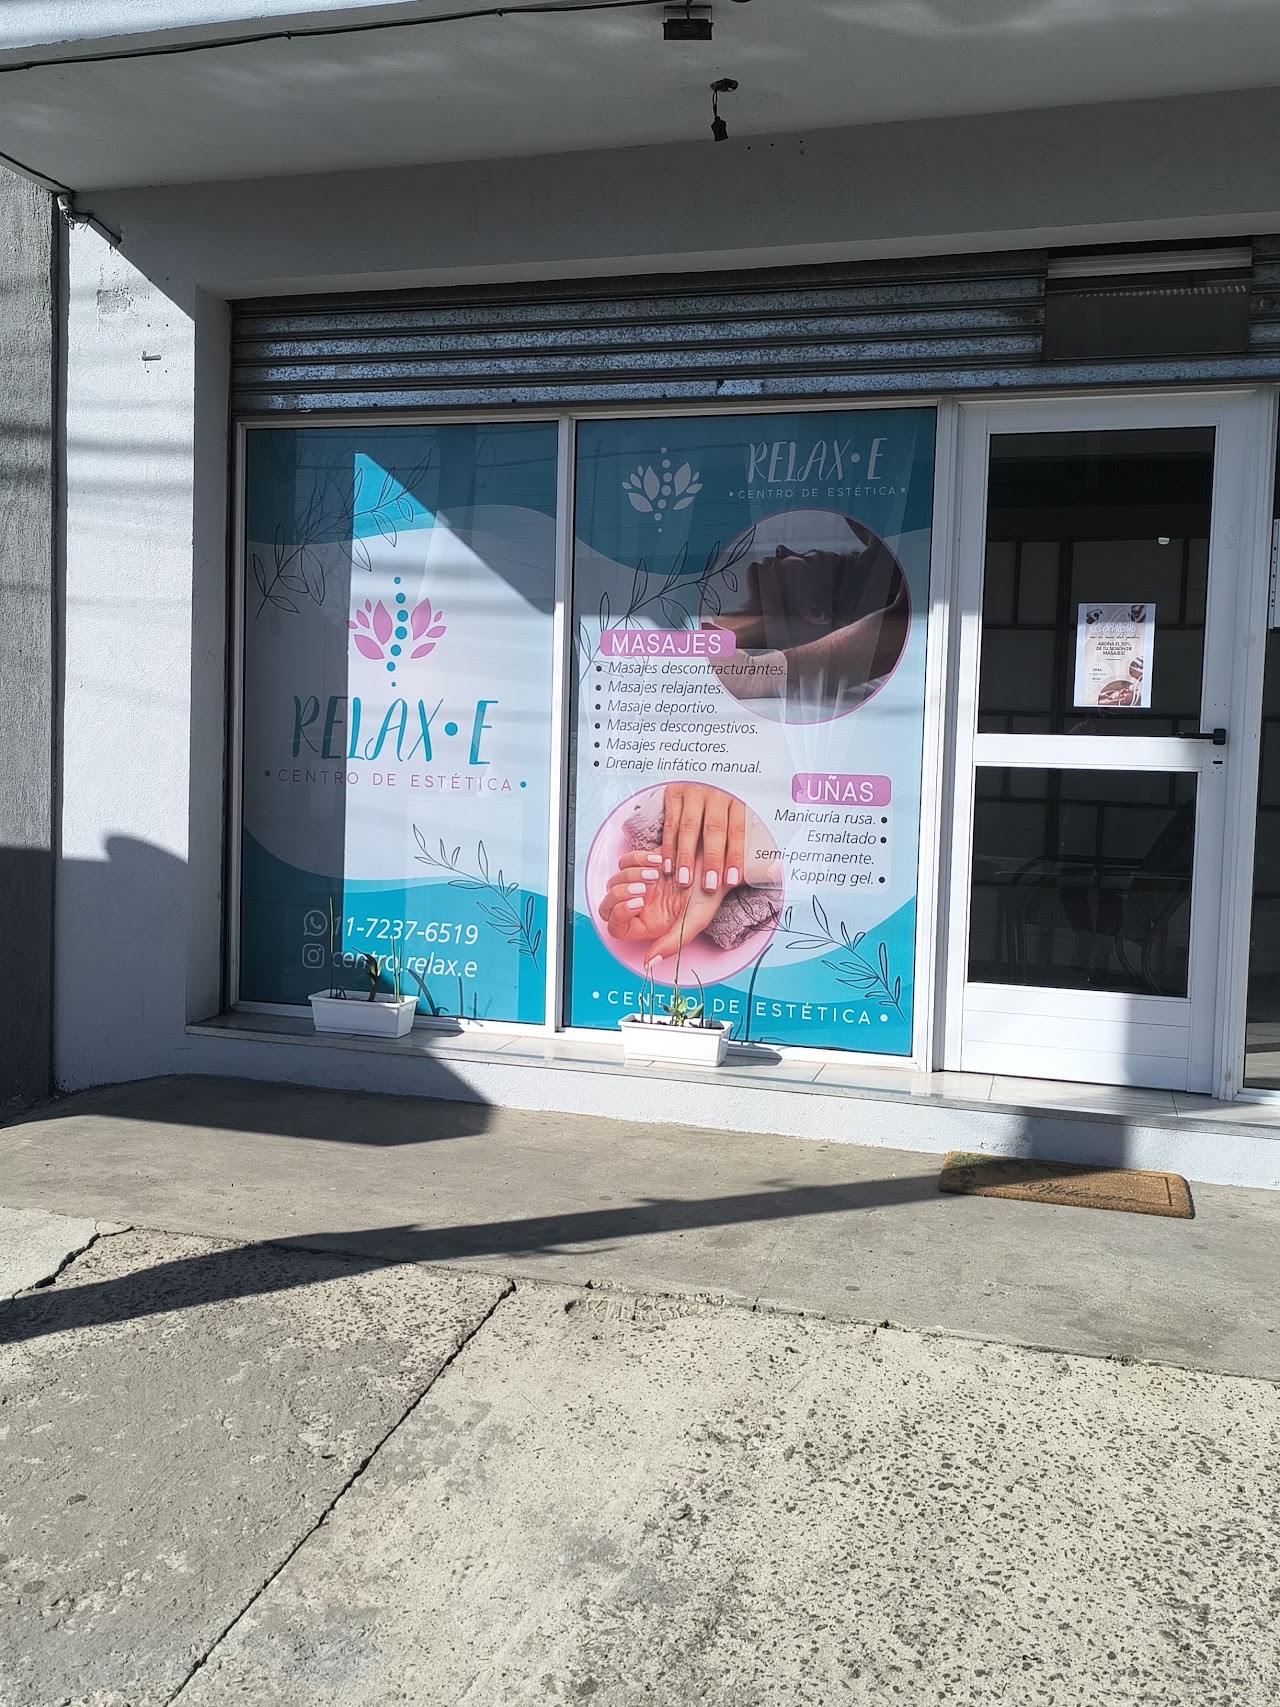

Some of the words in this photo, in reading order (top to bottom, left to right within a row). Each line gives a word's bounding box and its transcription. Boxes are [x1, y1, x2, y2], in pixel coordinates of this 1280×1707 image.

[738, 488, 794, 499] CENTRO
[802, 488, 819, 498] DE
[827, 484, 896, 497] ESTÉTICA
[610, 633, 722, 654] MASAJES
[608, 661, 658, 676] Masajes
[661, 662, 786, 676] descontracturantes.
[607, 680, 657, 695] Masajes
[660, 681, 725, 696] relajantes.
[607, 700, 651, 715] Masaje
[654, 700, 718, 715] deportivo.
[606, 718, 656, 733] Masajes
[660, 719, 758, 736] descongestivos.
[606, 738, 656, 753] Masajes
[659, 739, 729, 753] reductores.
[605, 757, 654, 772] Drenaje
[657, 757, 707, 772] linfático
[710, 760, 762, 773] manual.
[277, 768, 360, 785] CENTRO
[372, 772, 396, 786] DE
[410, 772, 512, 792] ESTÉTICA
[806, 774, 874, 802] UÑAS
[774, 808, 840, 823] Manicuría
[844, 813, 876, 825] rusa.
[807, 829, 877, 845] Esmaltado
[754, 847, 874, 865] semi-permanente.
[790, 868, 847, 886] Kapping
[849, 871, 874, 887] gel.
[333, 916, 479, 945] 11-7237-6519
[713, 998, 740, 1015] DE
[756, 1001, 872, 1025] ESTÉTICA
